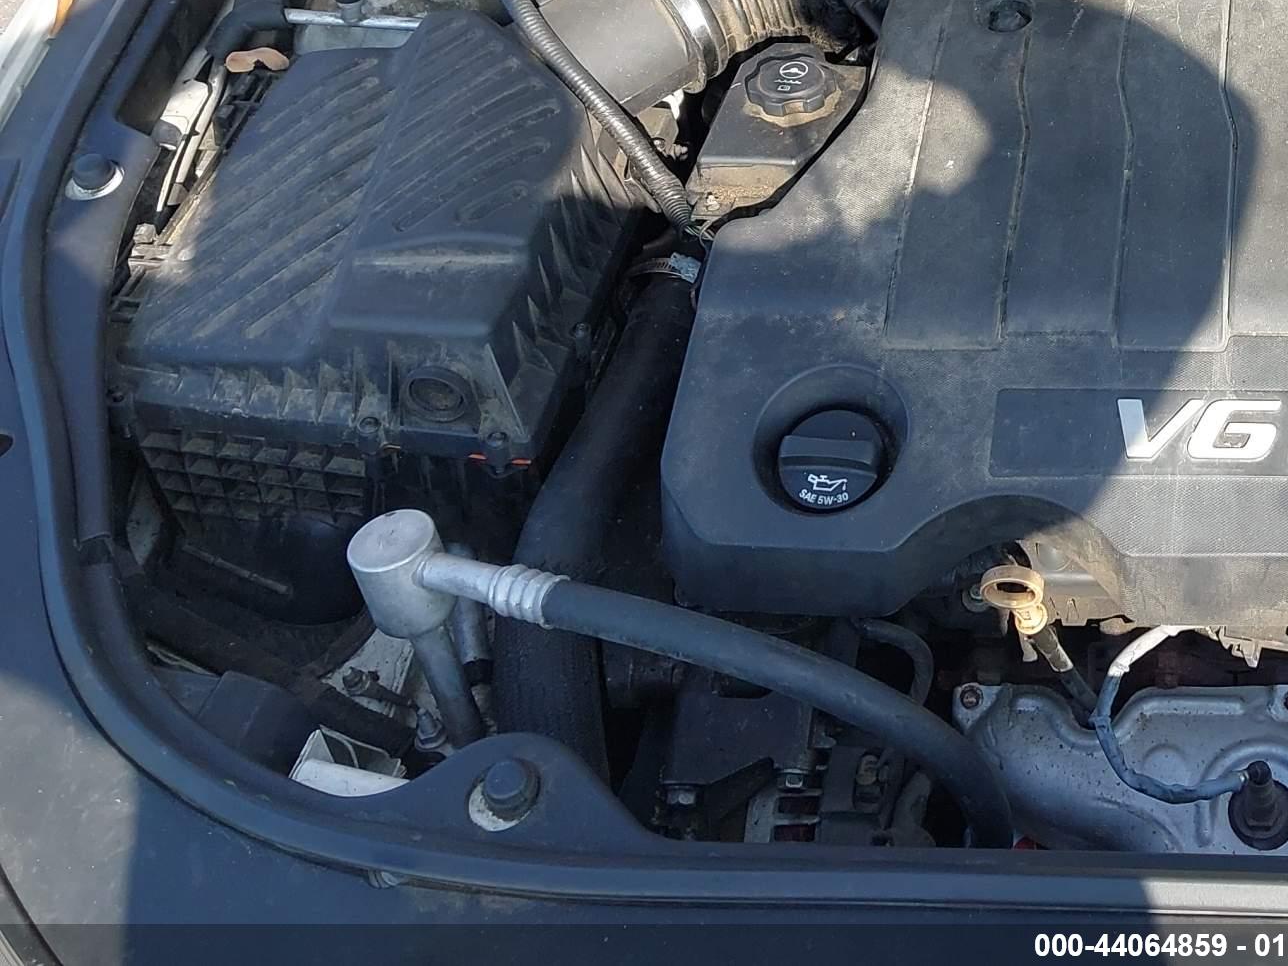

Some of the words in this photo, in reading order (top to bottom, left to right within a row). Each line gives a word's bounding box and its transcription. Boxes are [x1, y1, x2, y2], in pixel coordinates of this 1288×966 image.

[1116, 398, 1283, 462] V6
[798, 488, 818, 504] SAE
[817, 491, 849, 506] 5W-30
